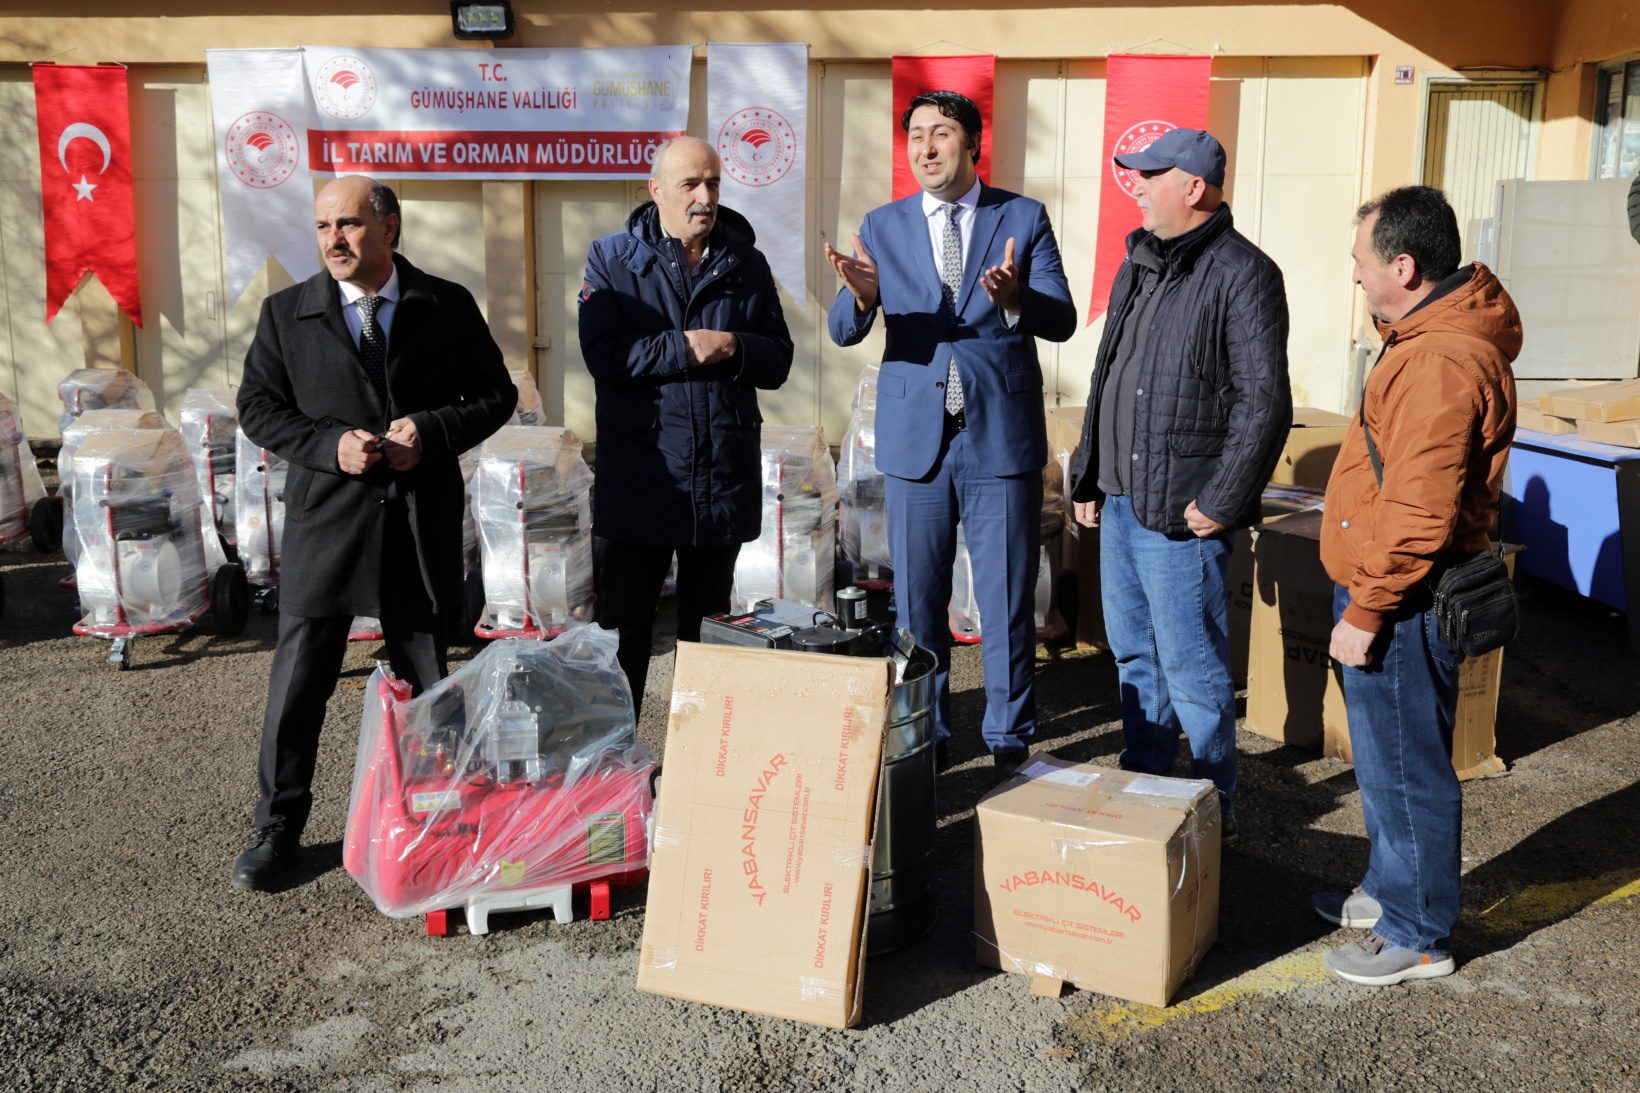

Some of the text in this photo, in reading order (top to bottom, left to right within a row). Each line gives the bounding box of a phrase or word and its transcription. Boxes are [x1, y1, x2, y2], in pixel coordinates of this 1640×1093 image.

[410, 87, 577, 113] GÜMÜŞHANE VALİLİĞİ
[478, 63, 507, 81] T.C.
[323, 138, 662, 165] İL TARIM VE ORMAN MÜDÜRLÜĞ
[716, 695, 734, 777] DİKKAT KIRILIR!
[834, 707, 853, 791] DİKKAT KIRILIR!
[741, 753, 789, 907] YABANSAVAR
[793, 786, 810, 882] www.yabansavar.com.tr
[695, 868, 713, 952] DİKKAT KIRILIR!
[814, 882, 833, 969] DİKKAT KIRILIR!
[999, 870, 1142, 924] YABANSAVAR
[1024, 920, 1113, 945] www.yabansavar.com.tr
